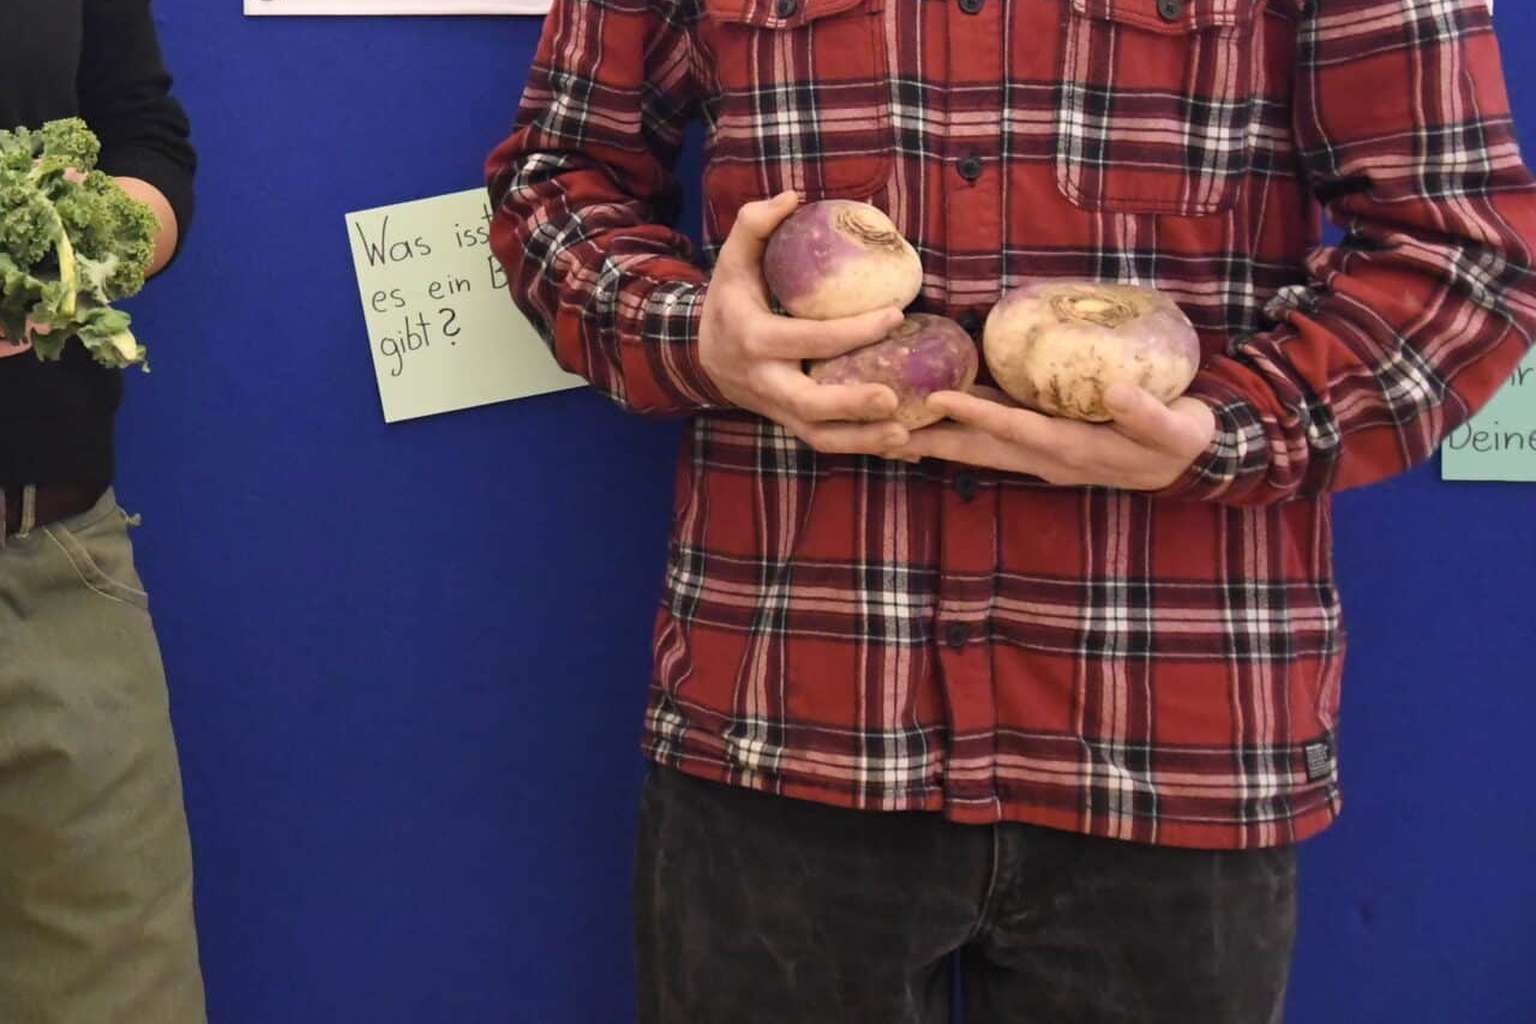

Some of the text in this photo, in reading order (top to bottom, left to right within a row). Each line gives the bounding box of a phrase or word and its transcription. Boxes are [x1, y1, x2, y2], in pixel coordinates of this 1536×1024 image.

[355, 215, 432, 267] Was
[371, 274, 471, 313] es ein
[379, 308, 462, 377] gibt?
